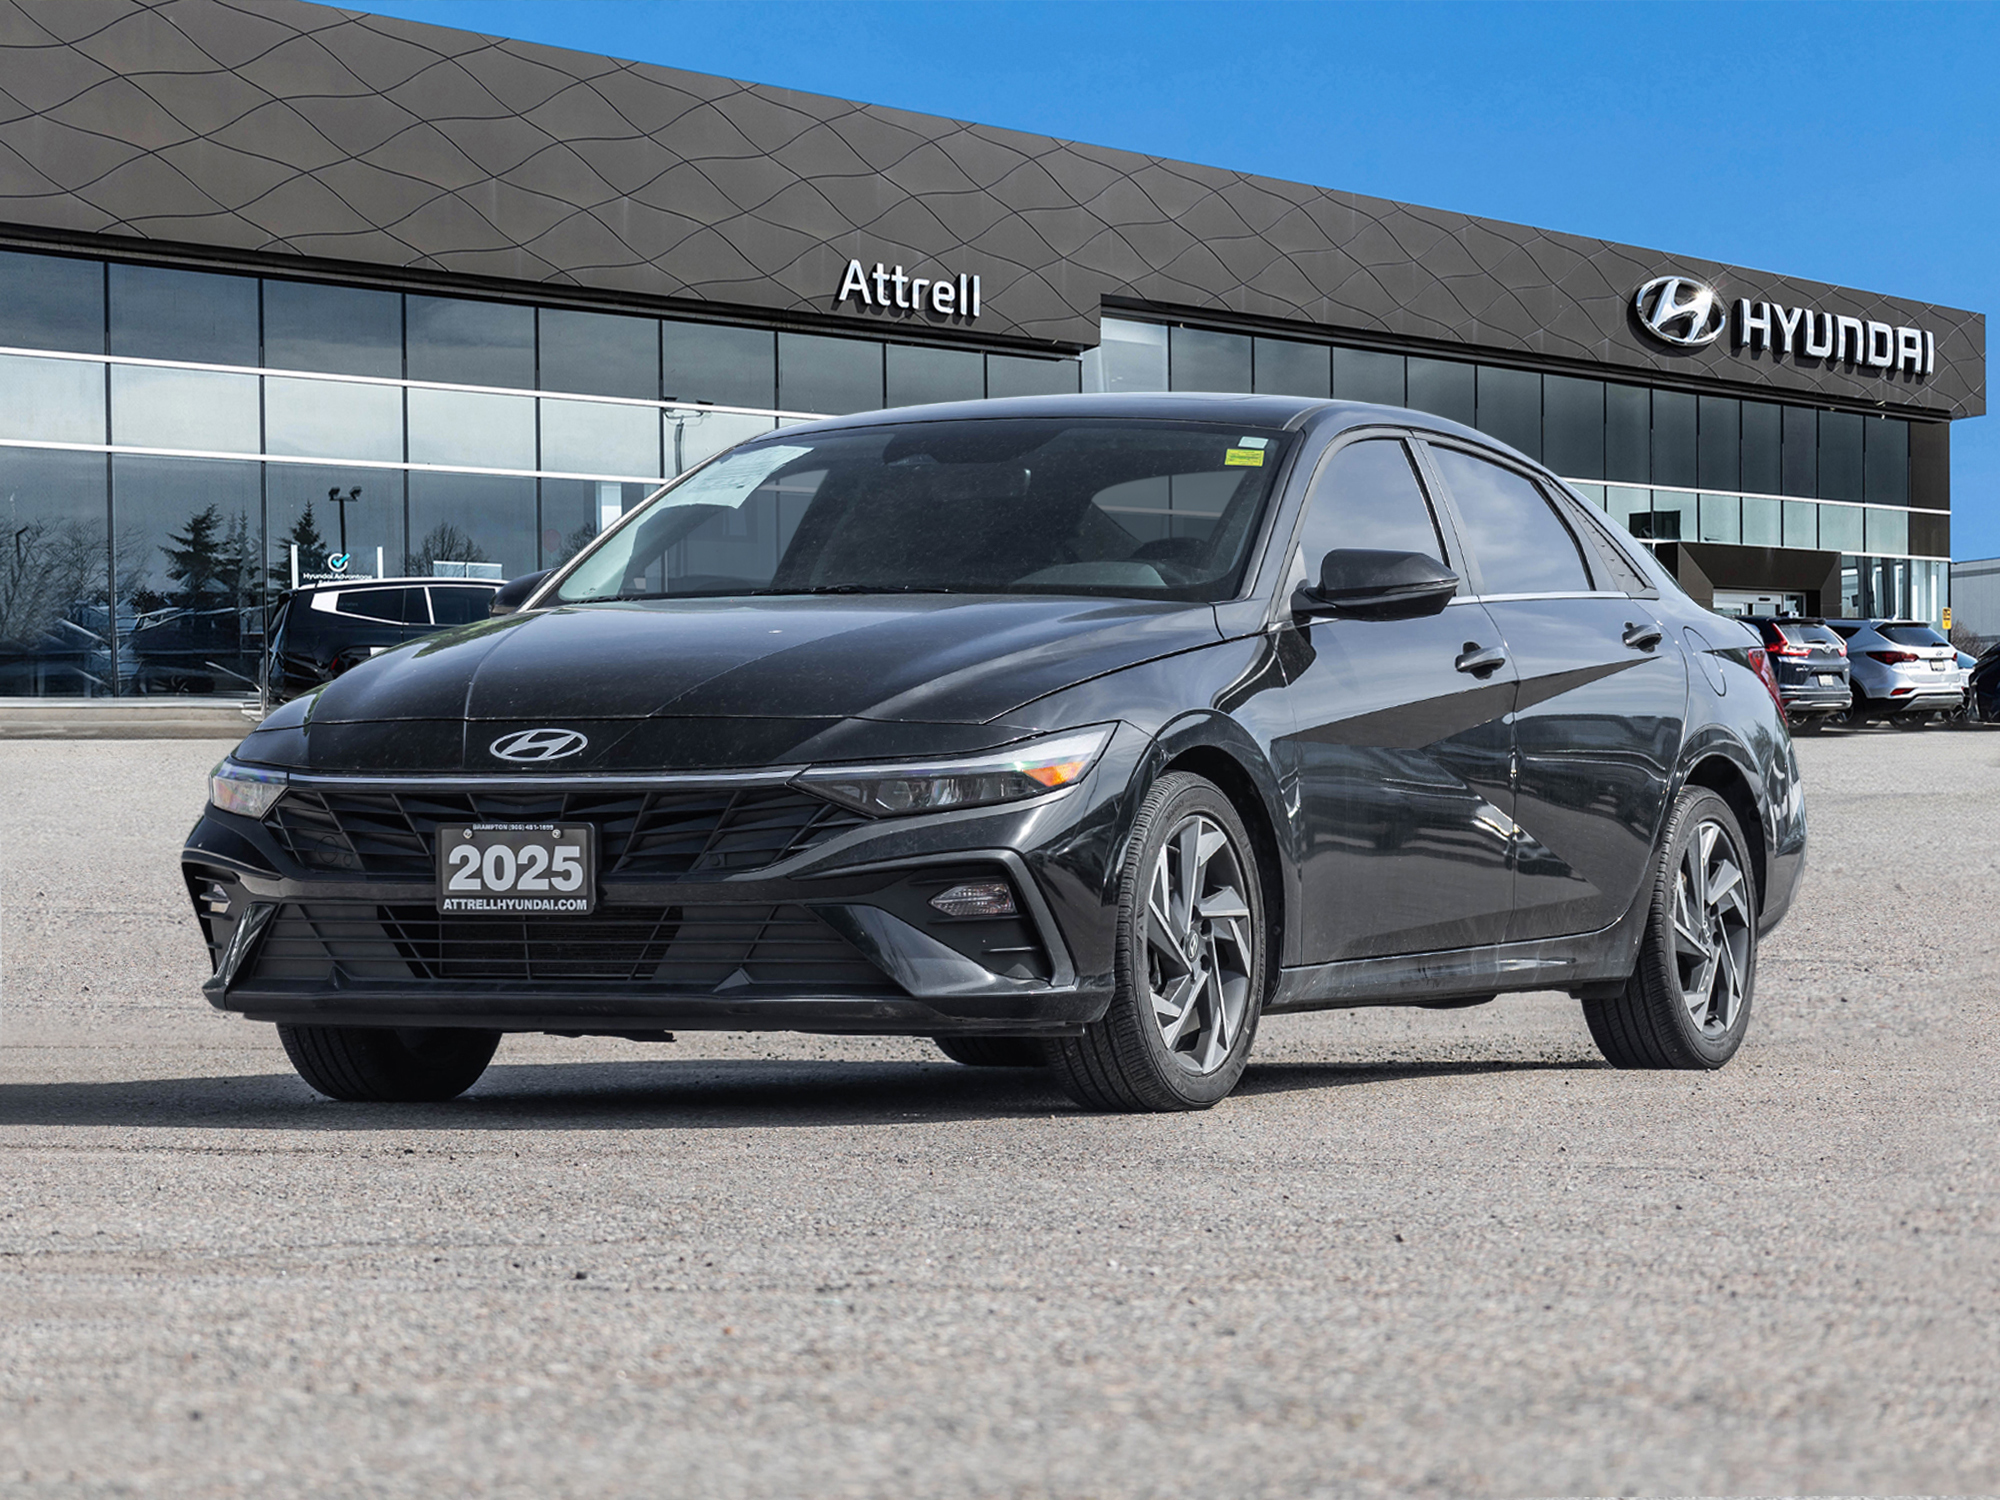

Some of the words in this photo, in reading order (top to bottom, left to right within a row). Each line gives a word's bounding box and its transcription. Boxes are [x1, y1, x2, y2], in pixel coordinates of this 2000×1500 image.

[837, 258, 980, 318] Attrell
[1738, 298, 1935, 376] HYUNDAI
[448, 844, 584, 892] 2025
[443, 898, 587, 911] ATTRELLHYUNDAI.COM
